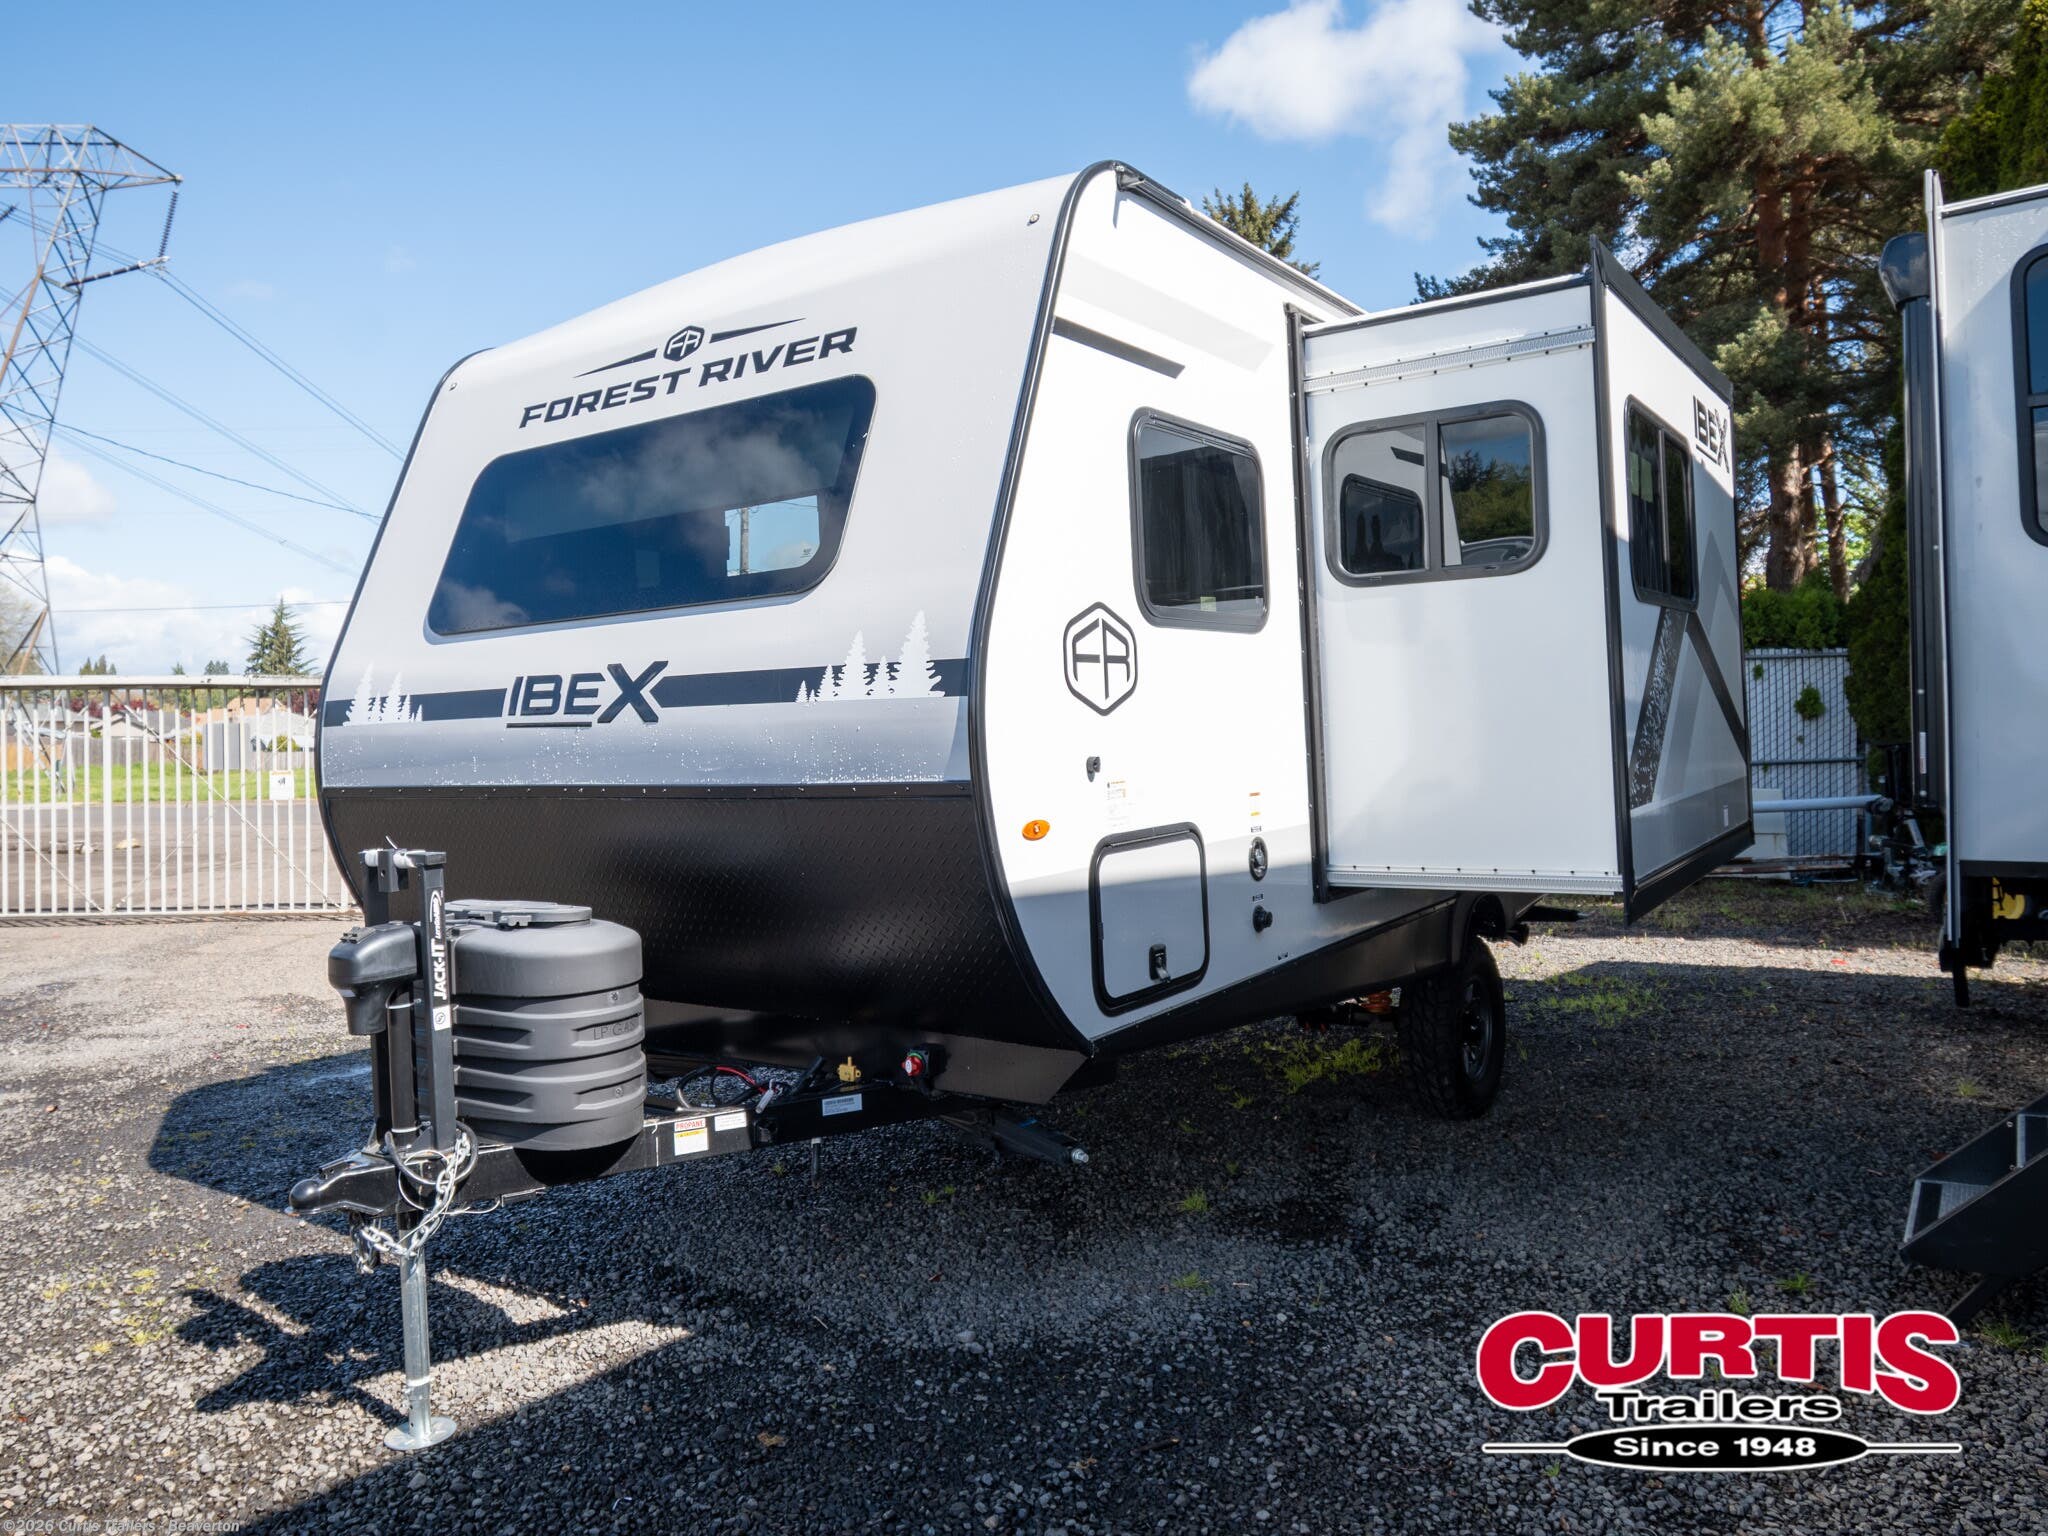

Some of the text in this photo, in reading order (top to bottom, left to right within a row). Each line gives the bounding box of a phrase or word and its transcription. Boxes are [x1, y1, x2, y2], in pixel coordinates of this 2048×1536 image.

[518, 326, 859, 430] FOREST RIVER
[1692, 394, 1730, 475] IBEX
[506, 659, 669, 724] IBEX
[430, 937, 447, 1001] JACK-IT
[675, 1119, 704, 1131] PROPANE
